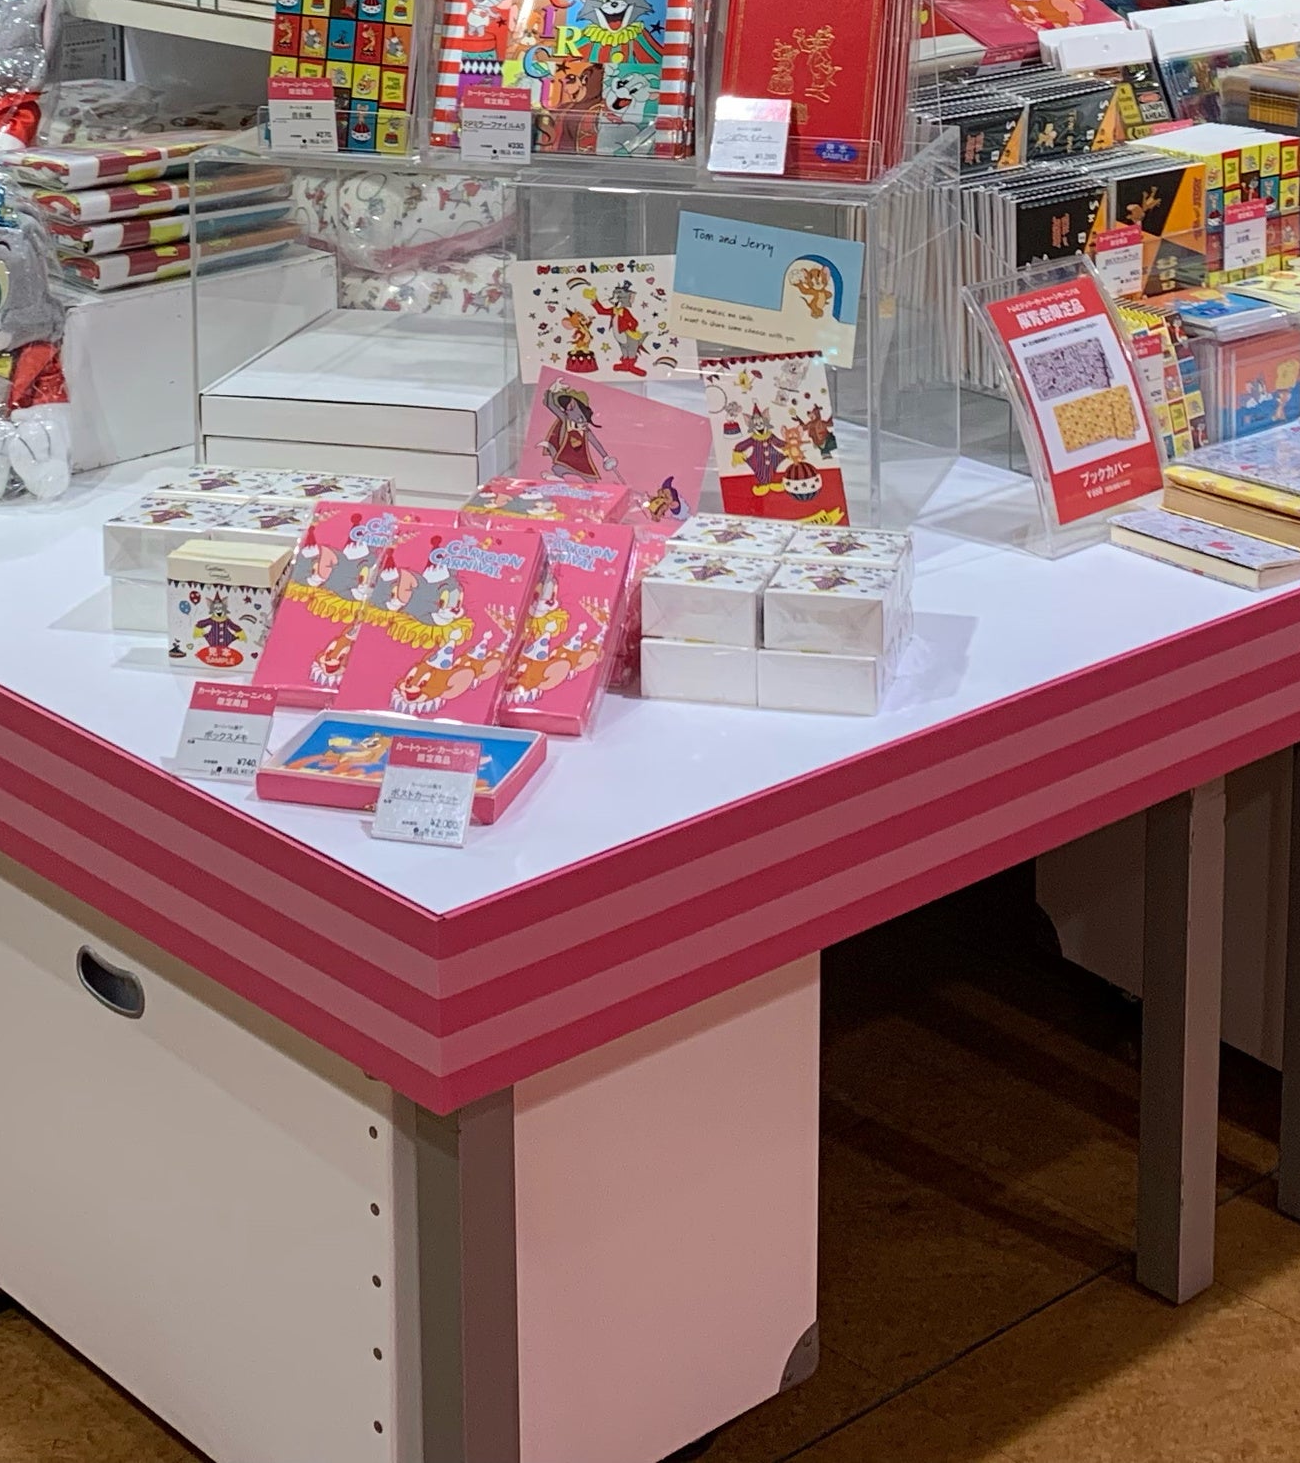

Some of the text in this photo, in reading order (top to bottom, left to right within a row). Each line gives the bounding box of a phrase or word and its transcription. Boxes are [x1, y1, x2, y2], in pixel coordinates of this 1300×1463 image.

[821, 151, 851, 162] SAMPLE
[692, 228, 775, 257] Tom and Jerry
[590, 261, 626, 275] have
[626, 259, 656, 273] fun
[1079, 462, 1132, 488] ブックカバー
[446, 538, 525, 571] CARTOON
[429, 548, 503, 579] CARNIVAL
[208, 648, 232, 657] 見本
[205, 656, 236, 666] SAMPLE
[197, 686, 274, 701] カートゥーン・カーニバル
[395, 742, 476, 757] カートゥーン・カーニバル
